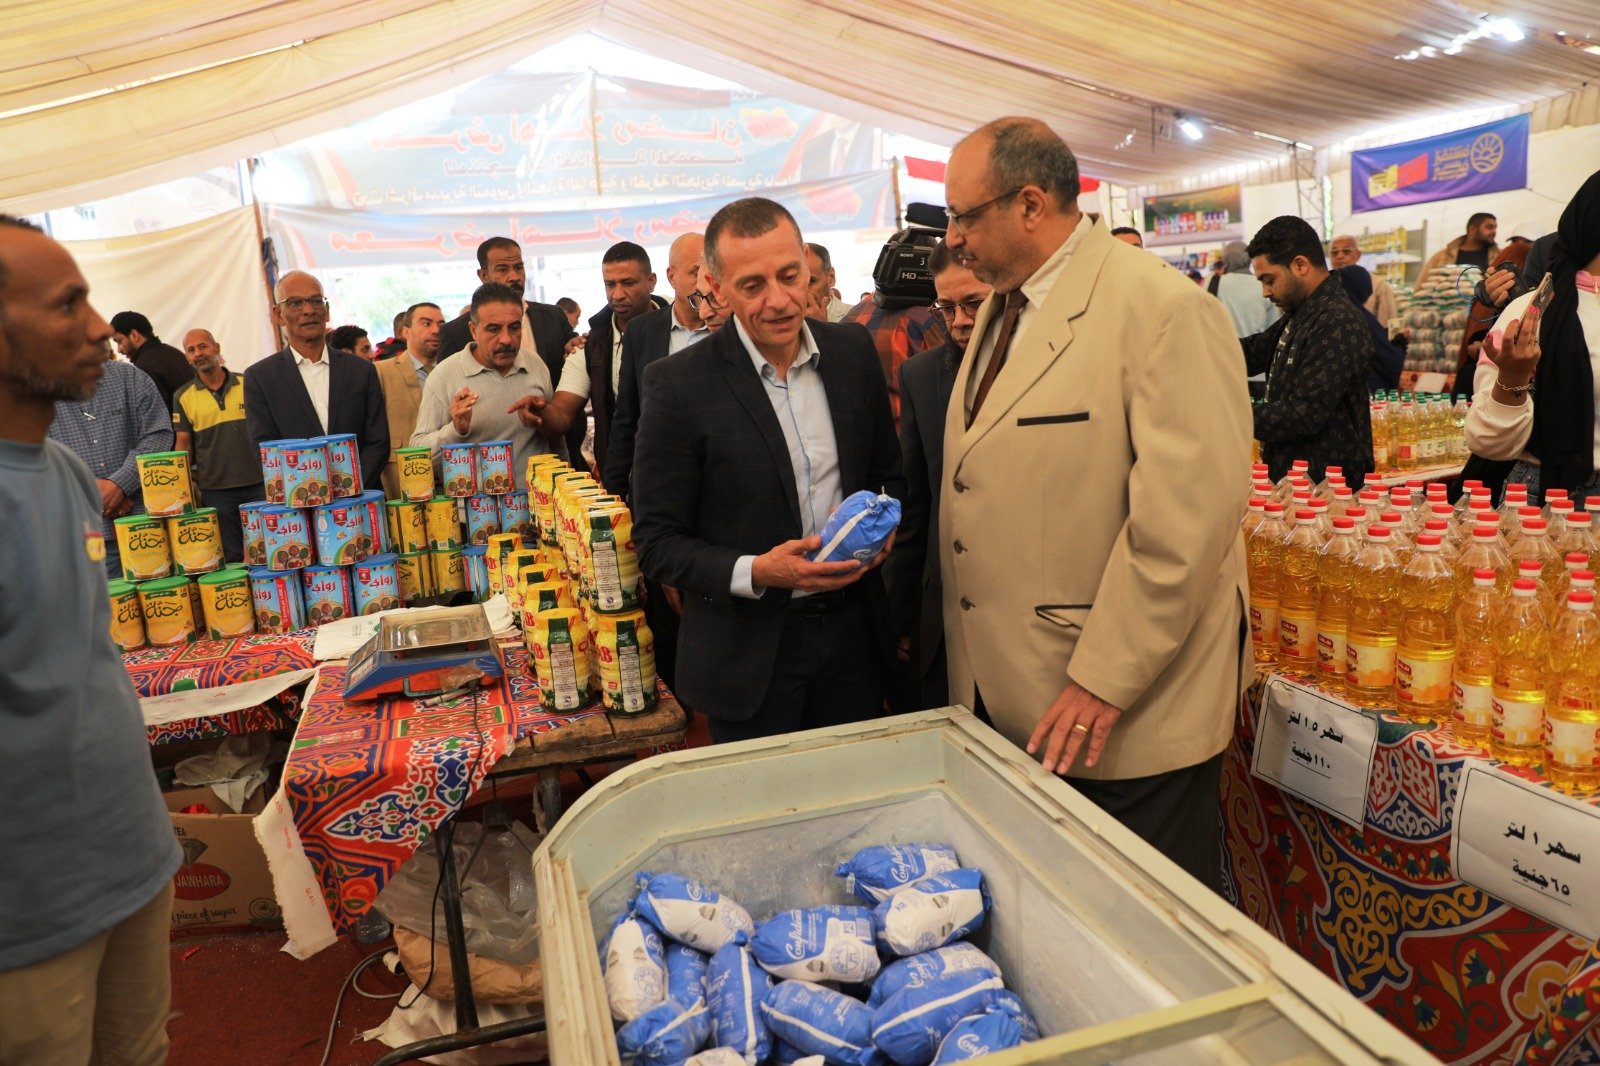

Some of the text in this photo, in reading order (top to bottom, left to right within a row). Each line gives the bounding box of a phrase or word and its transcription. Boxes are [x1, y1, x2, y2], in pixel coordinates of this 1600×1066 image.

[901, 271, 917, 280] HD
[1503, 822, 1526, 840] لتر
[176, 874, 224, 888] JAWHARA
[176, 909, 200, 923] piece
[200, 907, 211, 921] of
[210, 906, 237, 920] sugar
